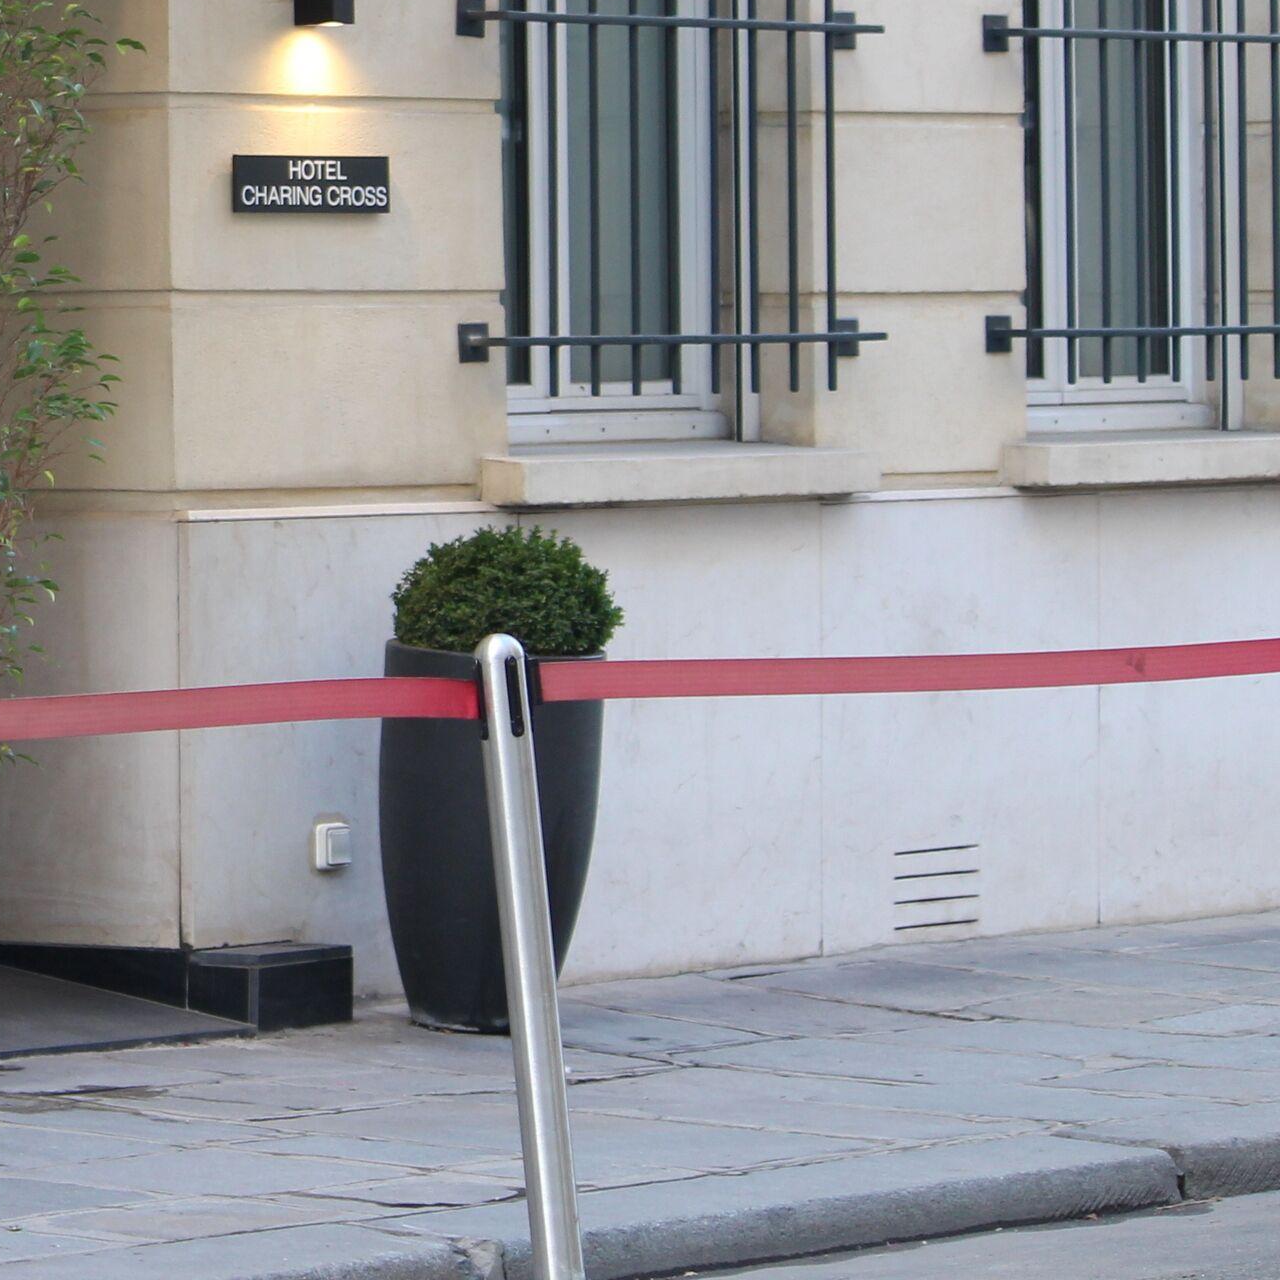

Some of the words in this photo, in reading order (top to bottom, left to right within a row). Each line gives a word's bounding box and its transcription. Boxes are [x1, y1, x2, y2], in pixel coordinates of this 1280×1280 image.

[289, 160, 347, 181] HOTEL
[241, 185, 322, 206] CHARING
[326, 186, 388, 207] CROSS
